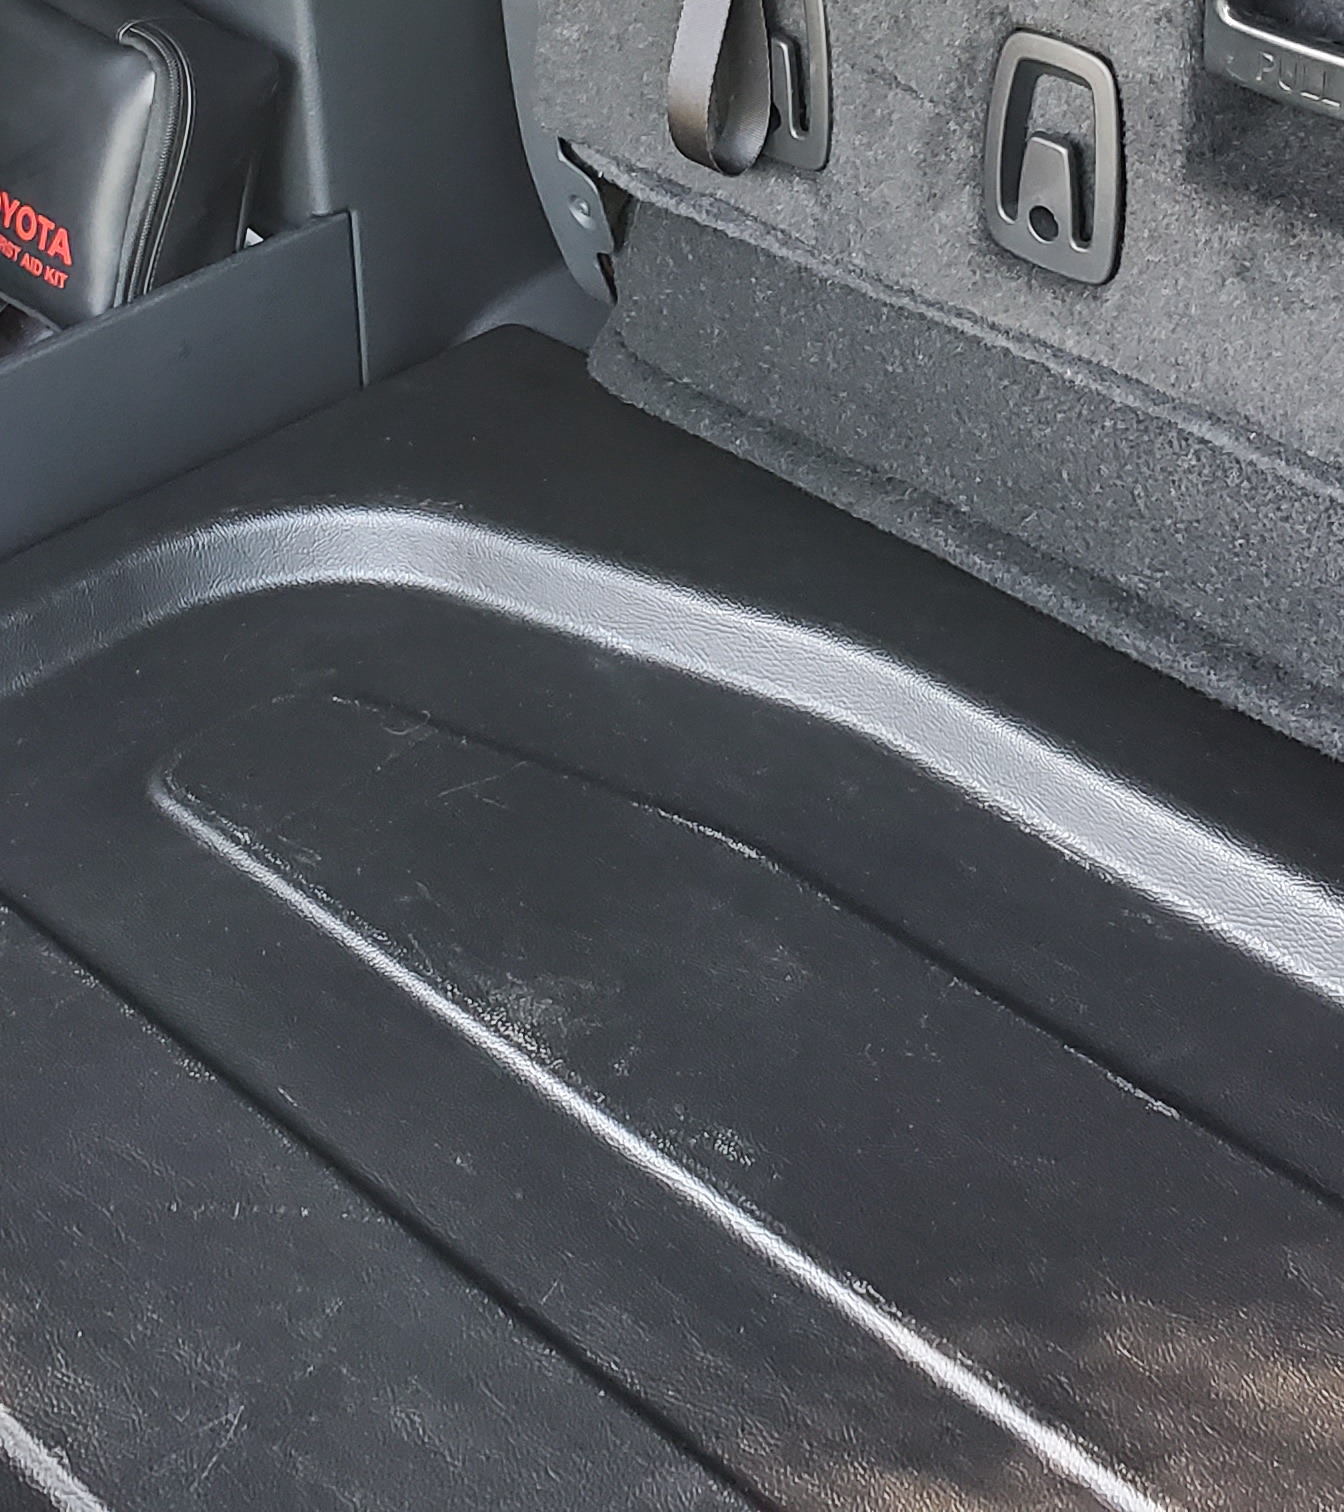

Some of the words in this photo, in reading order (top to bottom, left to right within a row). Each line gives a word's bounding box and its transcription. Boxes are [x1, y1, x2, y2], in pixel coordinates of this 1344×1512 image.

[1258, 52, 1341, 109] PULL
[20, 251, 43, 277] AID
[44, 265, 69, 289] KIT
